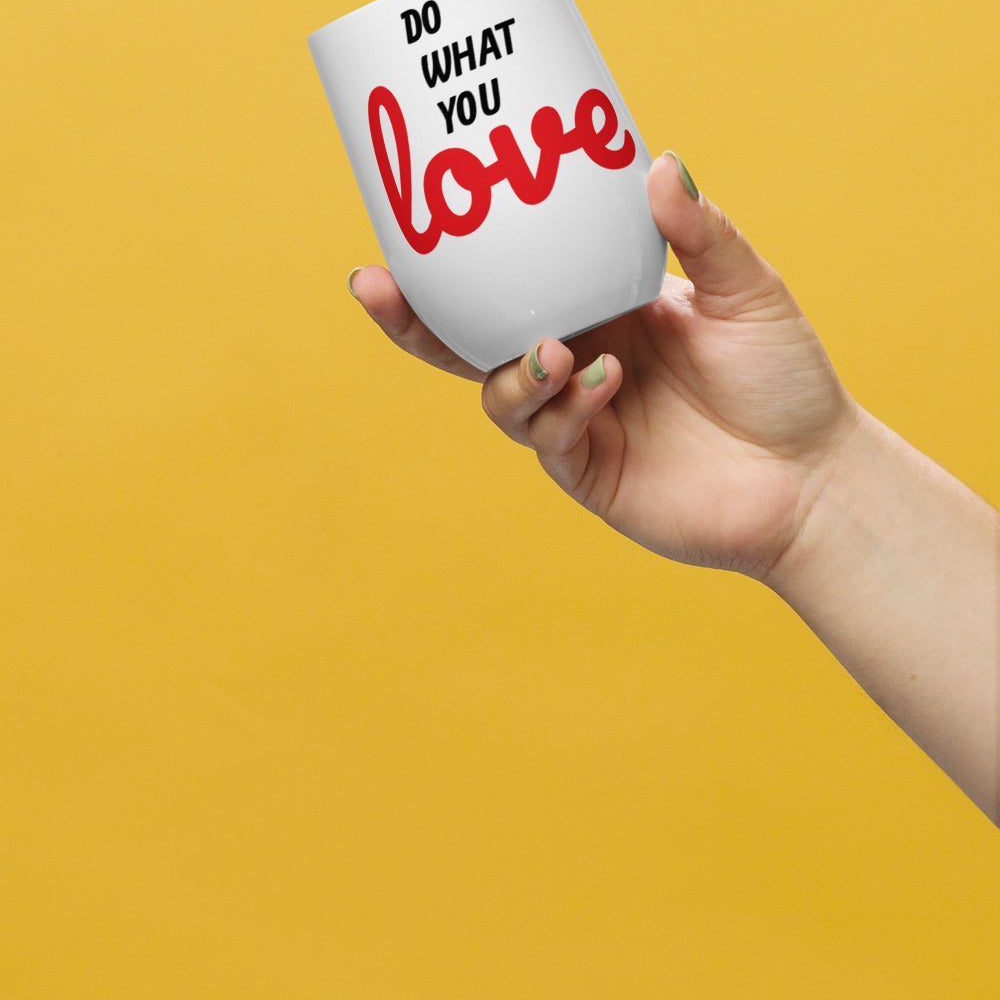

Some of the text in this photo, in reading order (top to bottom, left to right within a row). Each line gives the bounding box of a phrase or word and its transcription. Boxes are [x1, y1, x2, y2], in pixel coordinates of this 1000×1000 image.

[401, 0, 442, 45] DO
[421, 17, 516, 89] WHAT
[437, 77, 501, 135] YOU
[368, 86, 636, 254] love
